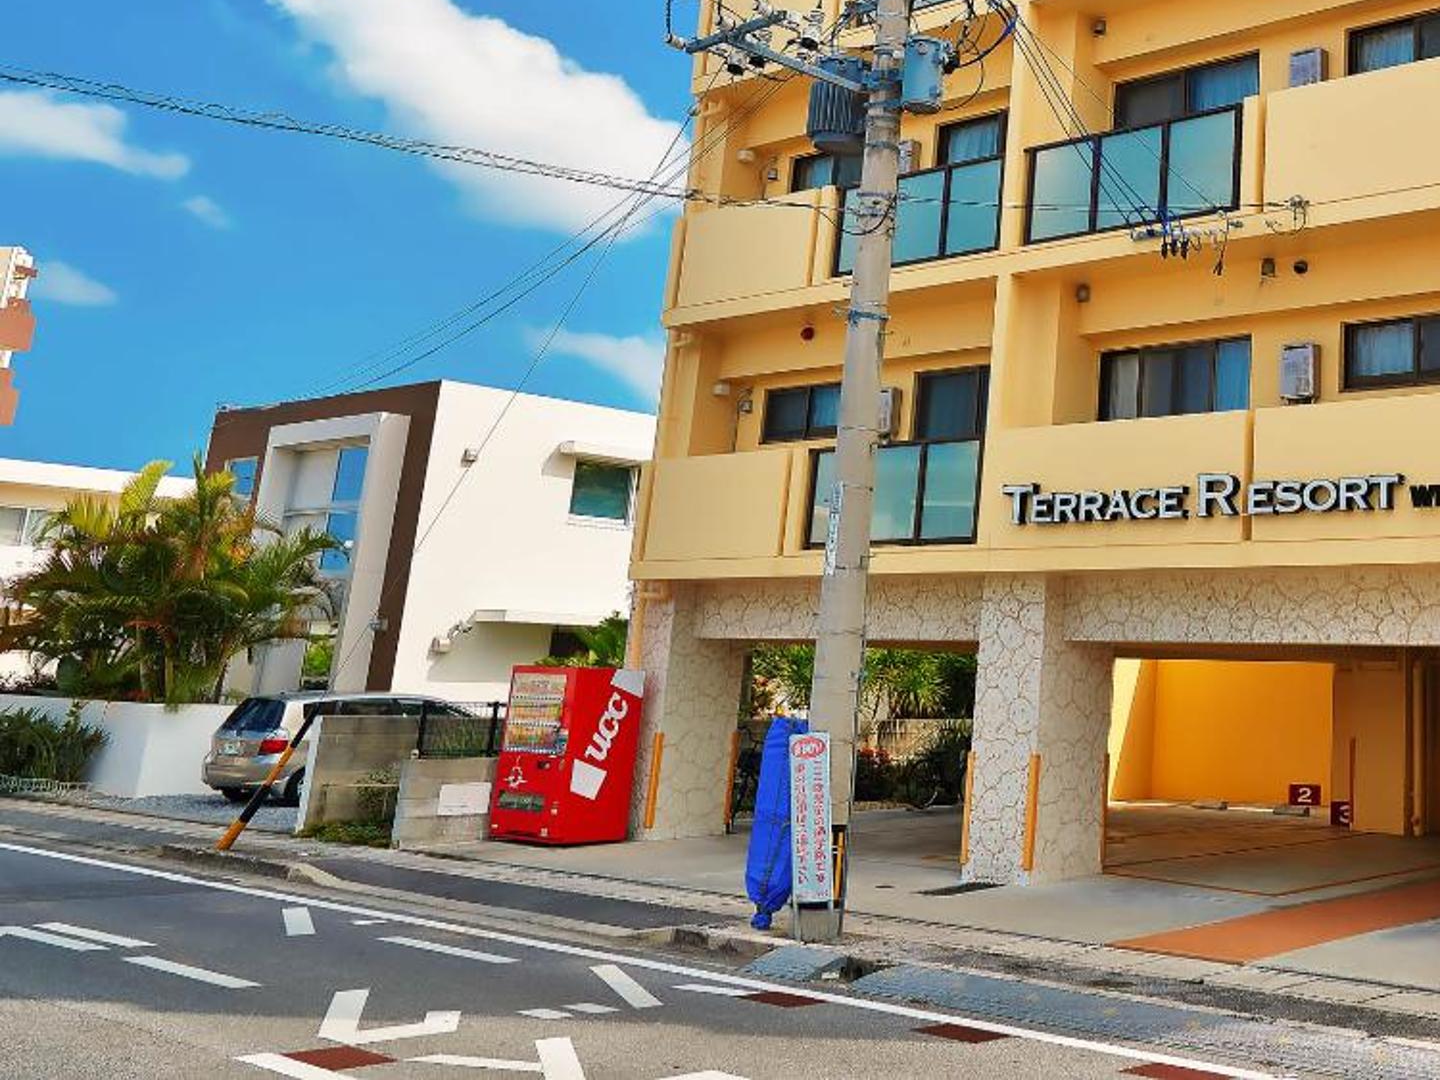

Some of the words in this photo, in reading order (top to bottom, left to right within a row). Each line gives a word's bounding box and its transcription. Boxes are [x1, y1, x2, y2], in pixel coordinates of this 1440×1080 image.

[1003, 482, 1189, 525] TERRACE
[1197, 473, 1404, 518] RESORT
[1297, 788, 1312, 803] 2
